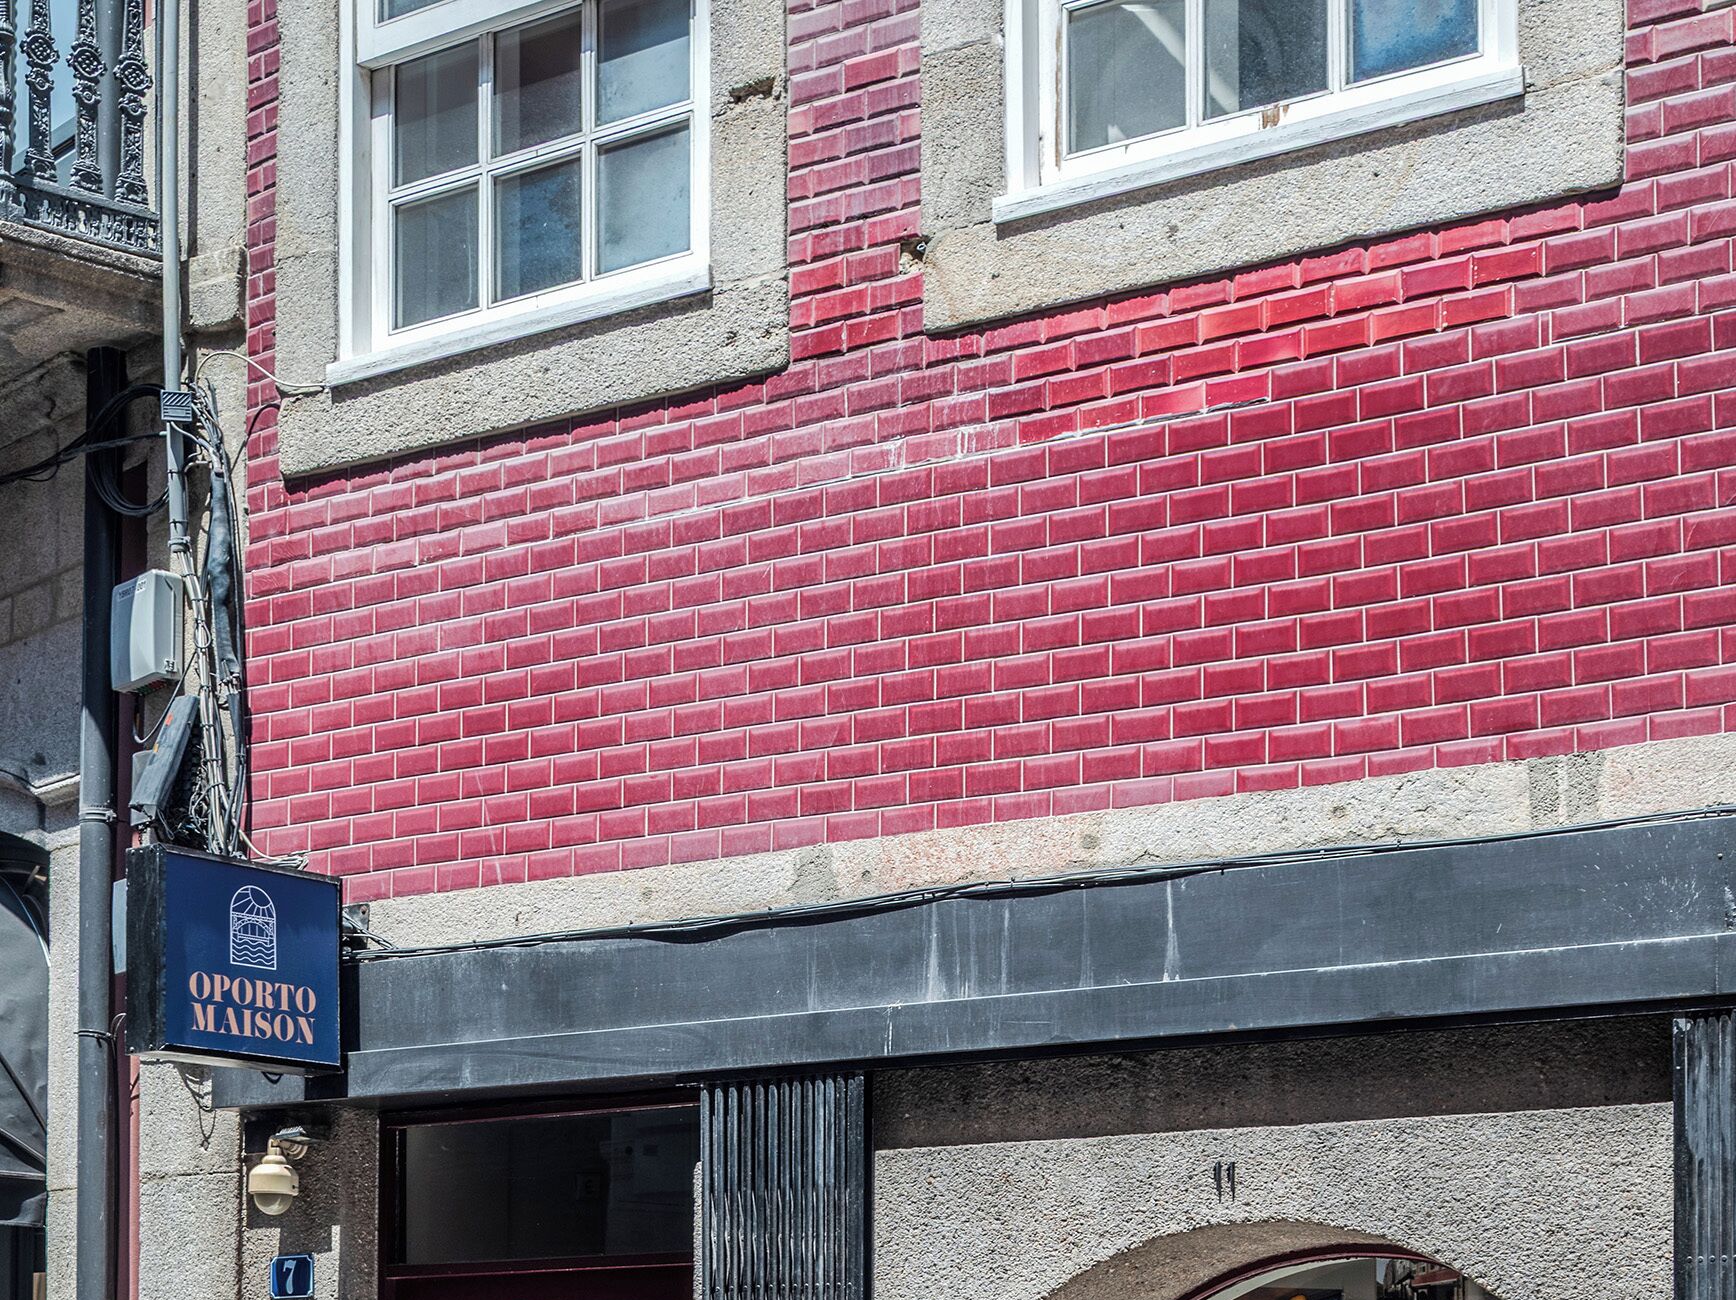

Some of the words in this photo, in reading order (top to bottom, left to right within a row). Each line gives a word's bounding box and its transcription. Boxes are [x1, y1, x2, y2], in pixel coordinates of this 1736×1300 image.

[189, 971, 316, 1014] OPORTO
[191, 1002, 315, 1045] MAISON
[283, 1260, 297, 1294] 7
